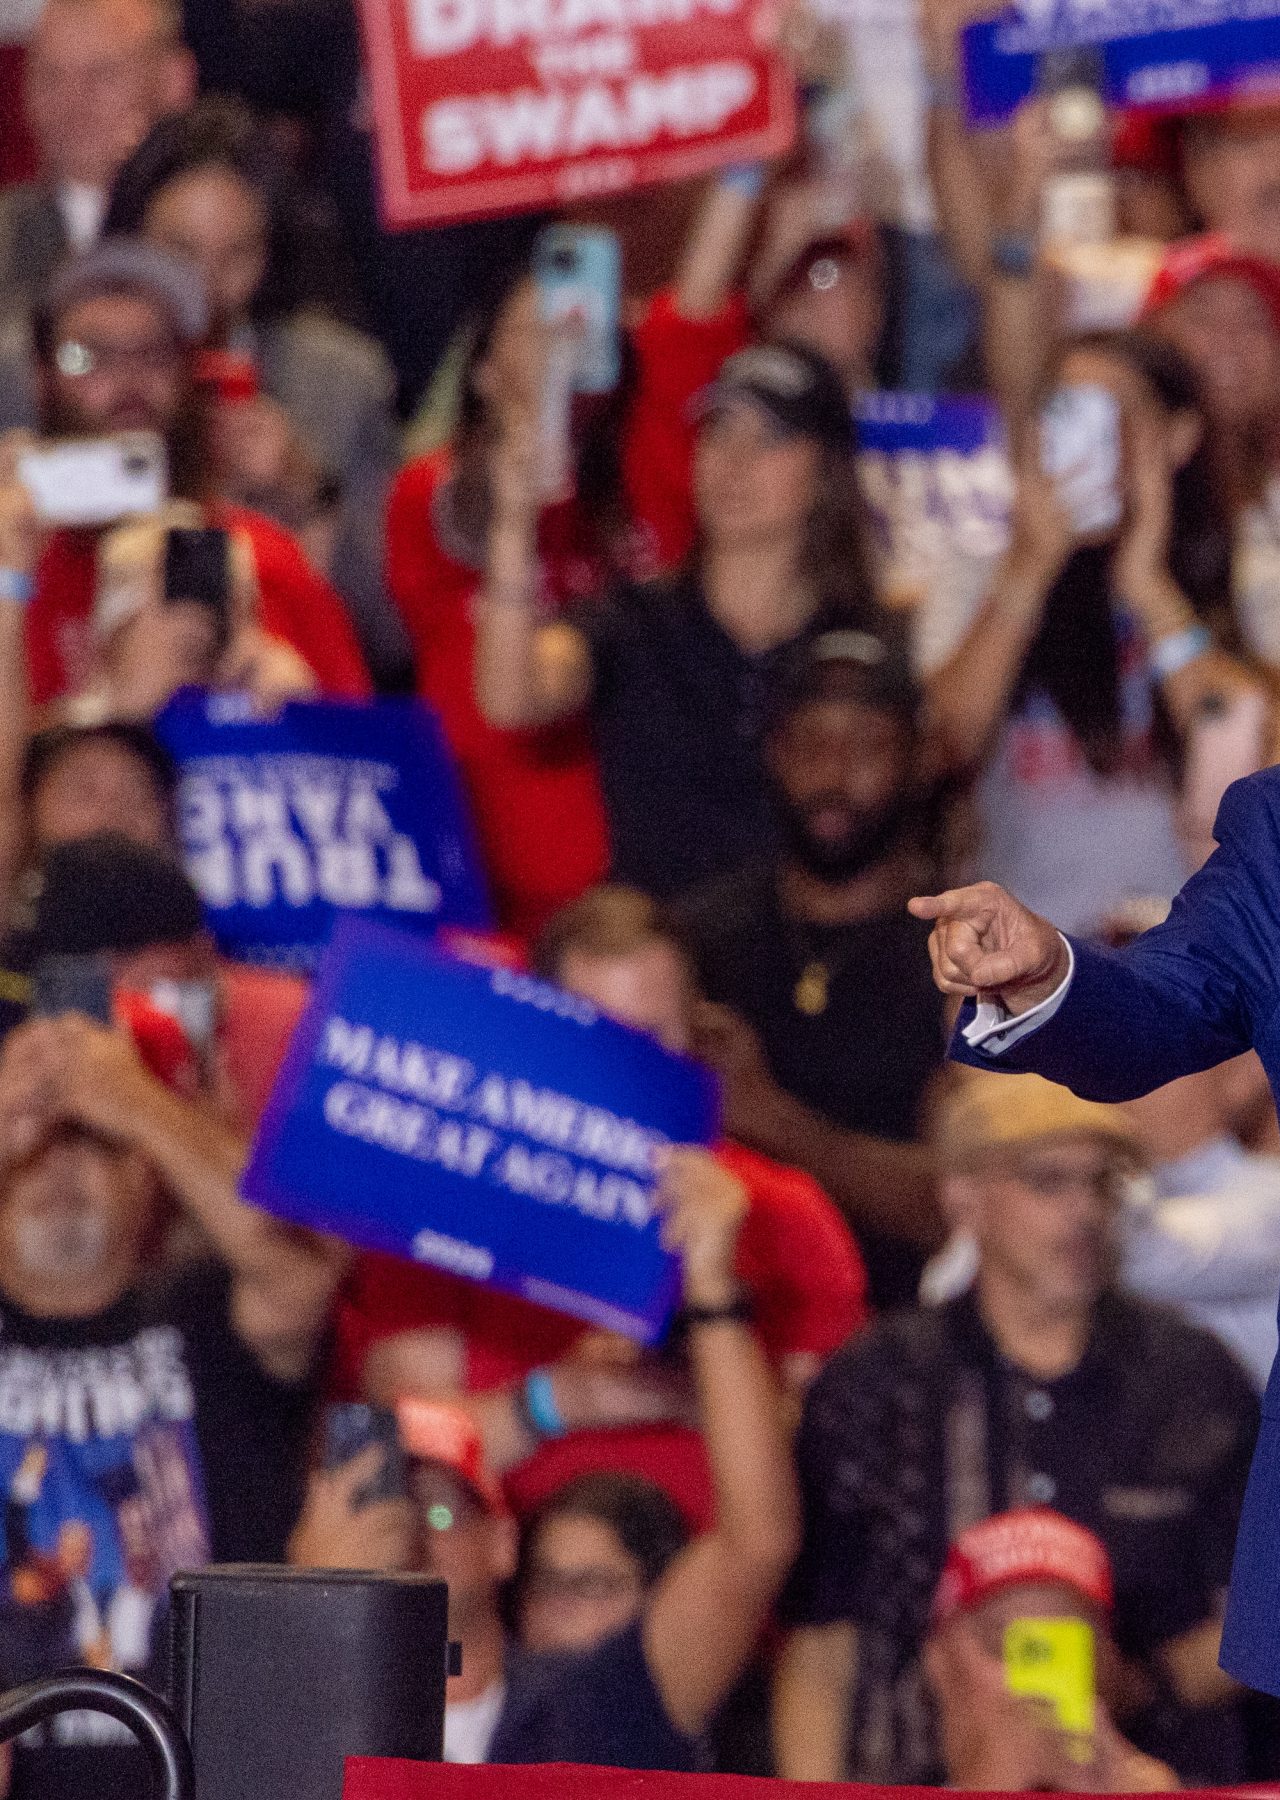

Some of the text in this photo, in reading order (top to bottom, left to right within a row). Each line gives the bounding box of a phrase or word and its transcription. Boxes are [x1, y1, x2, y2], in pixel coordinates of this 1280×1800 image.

[408, 0, 742, 58] DRA
[422, 62, 755, 174] SWAMP
[182, 833, 442, 912] TRUM
[320, 1015, 670, 1177] MAKE AMERIC
[323, 1079, 654, 1230] GREAT AGAIN
